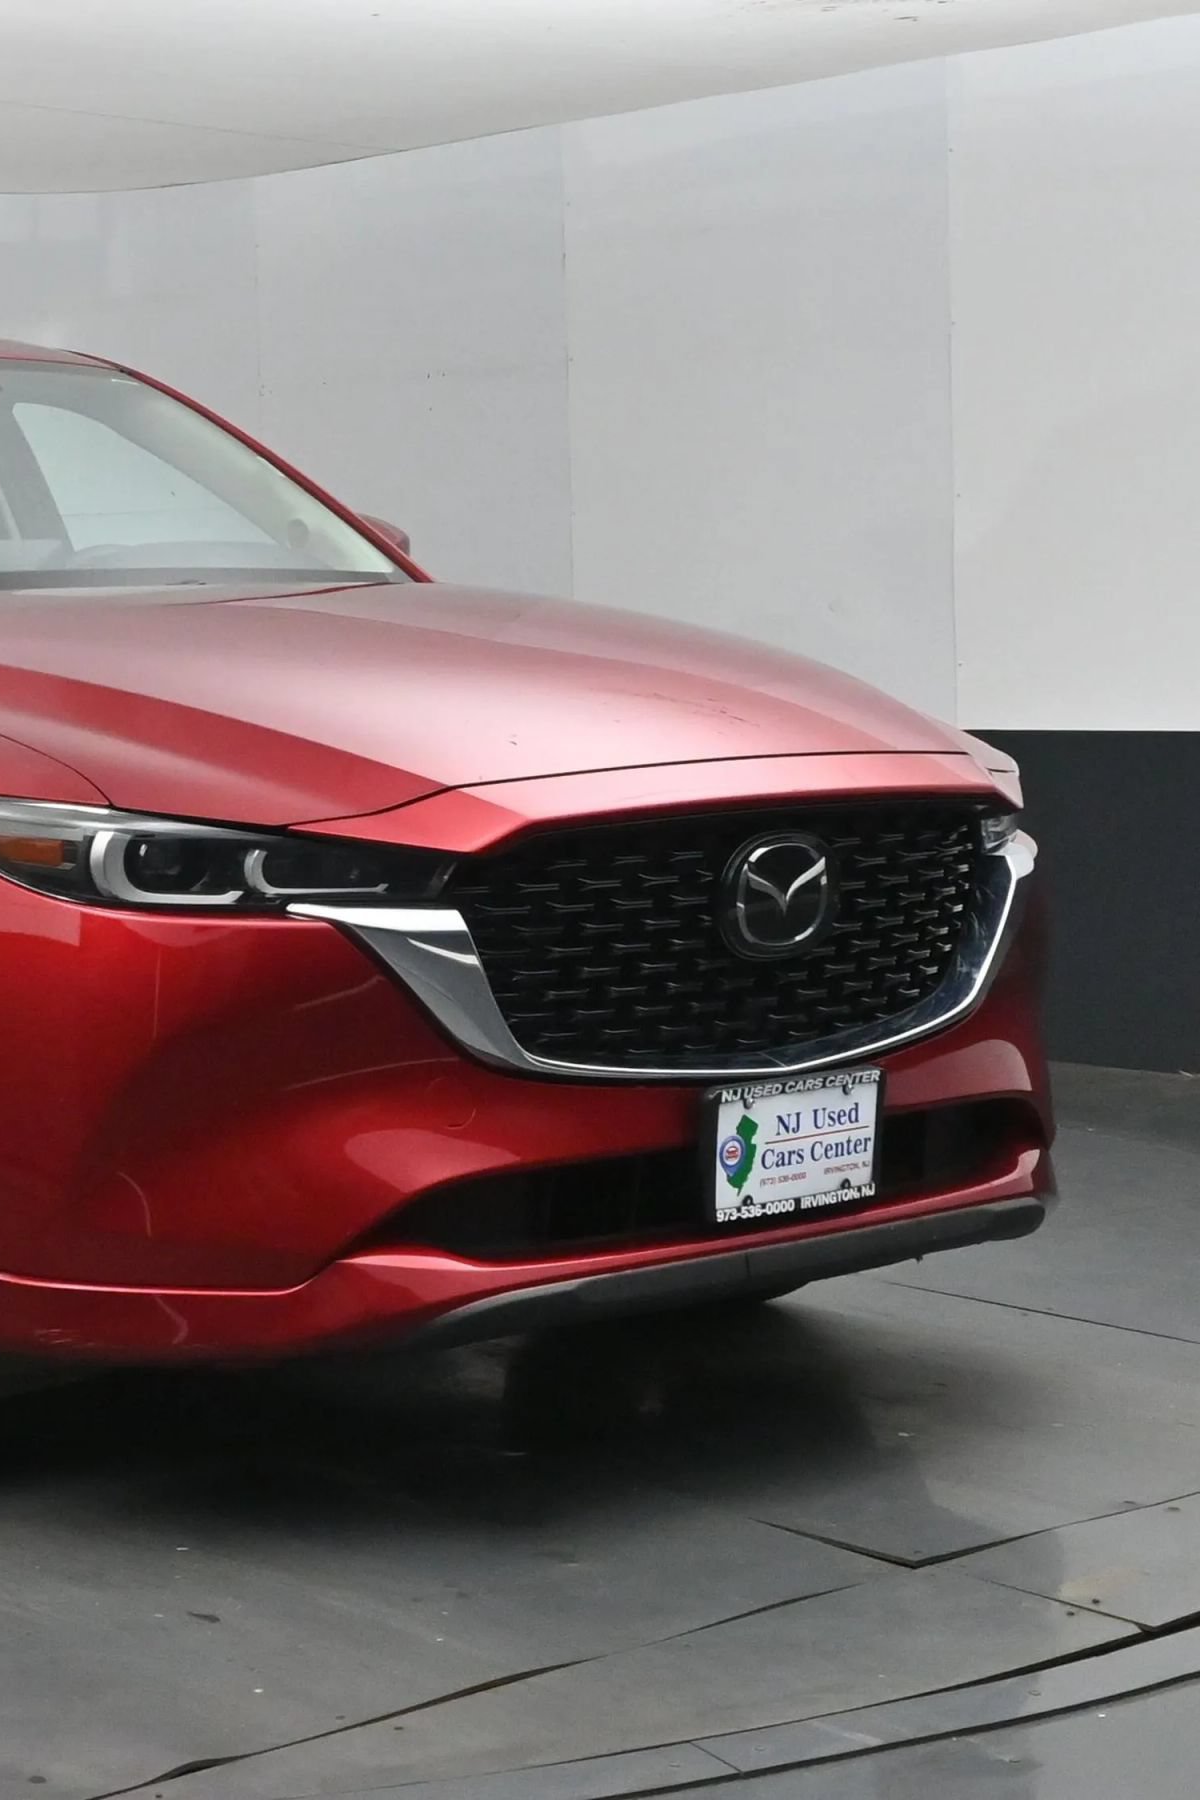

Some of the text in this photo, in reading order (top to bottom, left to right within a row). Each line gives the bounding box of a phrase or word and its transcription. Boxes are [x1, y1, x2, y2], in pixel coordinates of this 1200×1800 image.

[721, 1070, 881, 1103] NJ USED CARS CENTER
[775, 1102, 859, 1136] NJ Used
[761, 1135, 872, 1170] Cars Center
[716, 1199, 795, 1222] 973-536-0000
[861, 1183, 876, 1197] NJ
